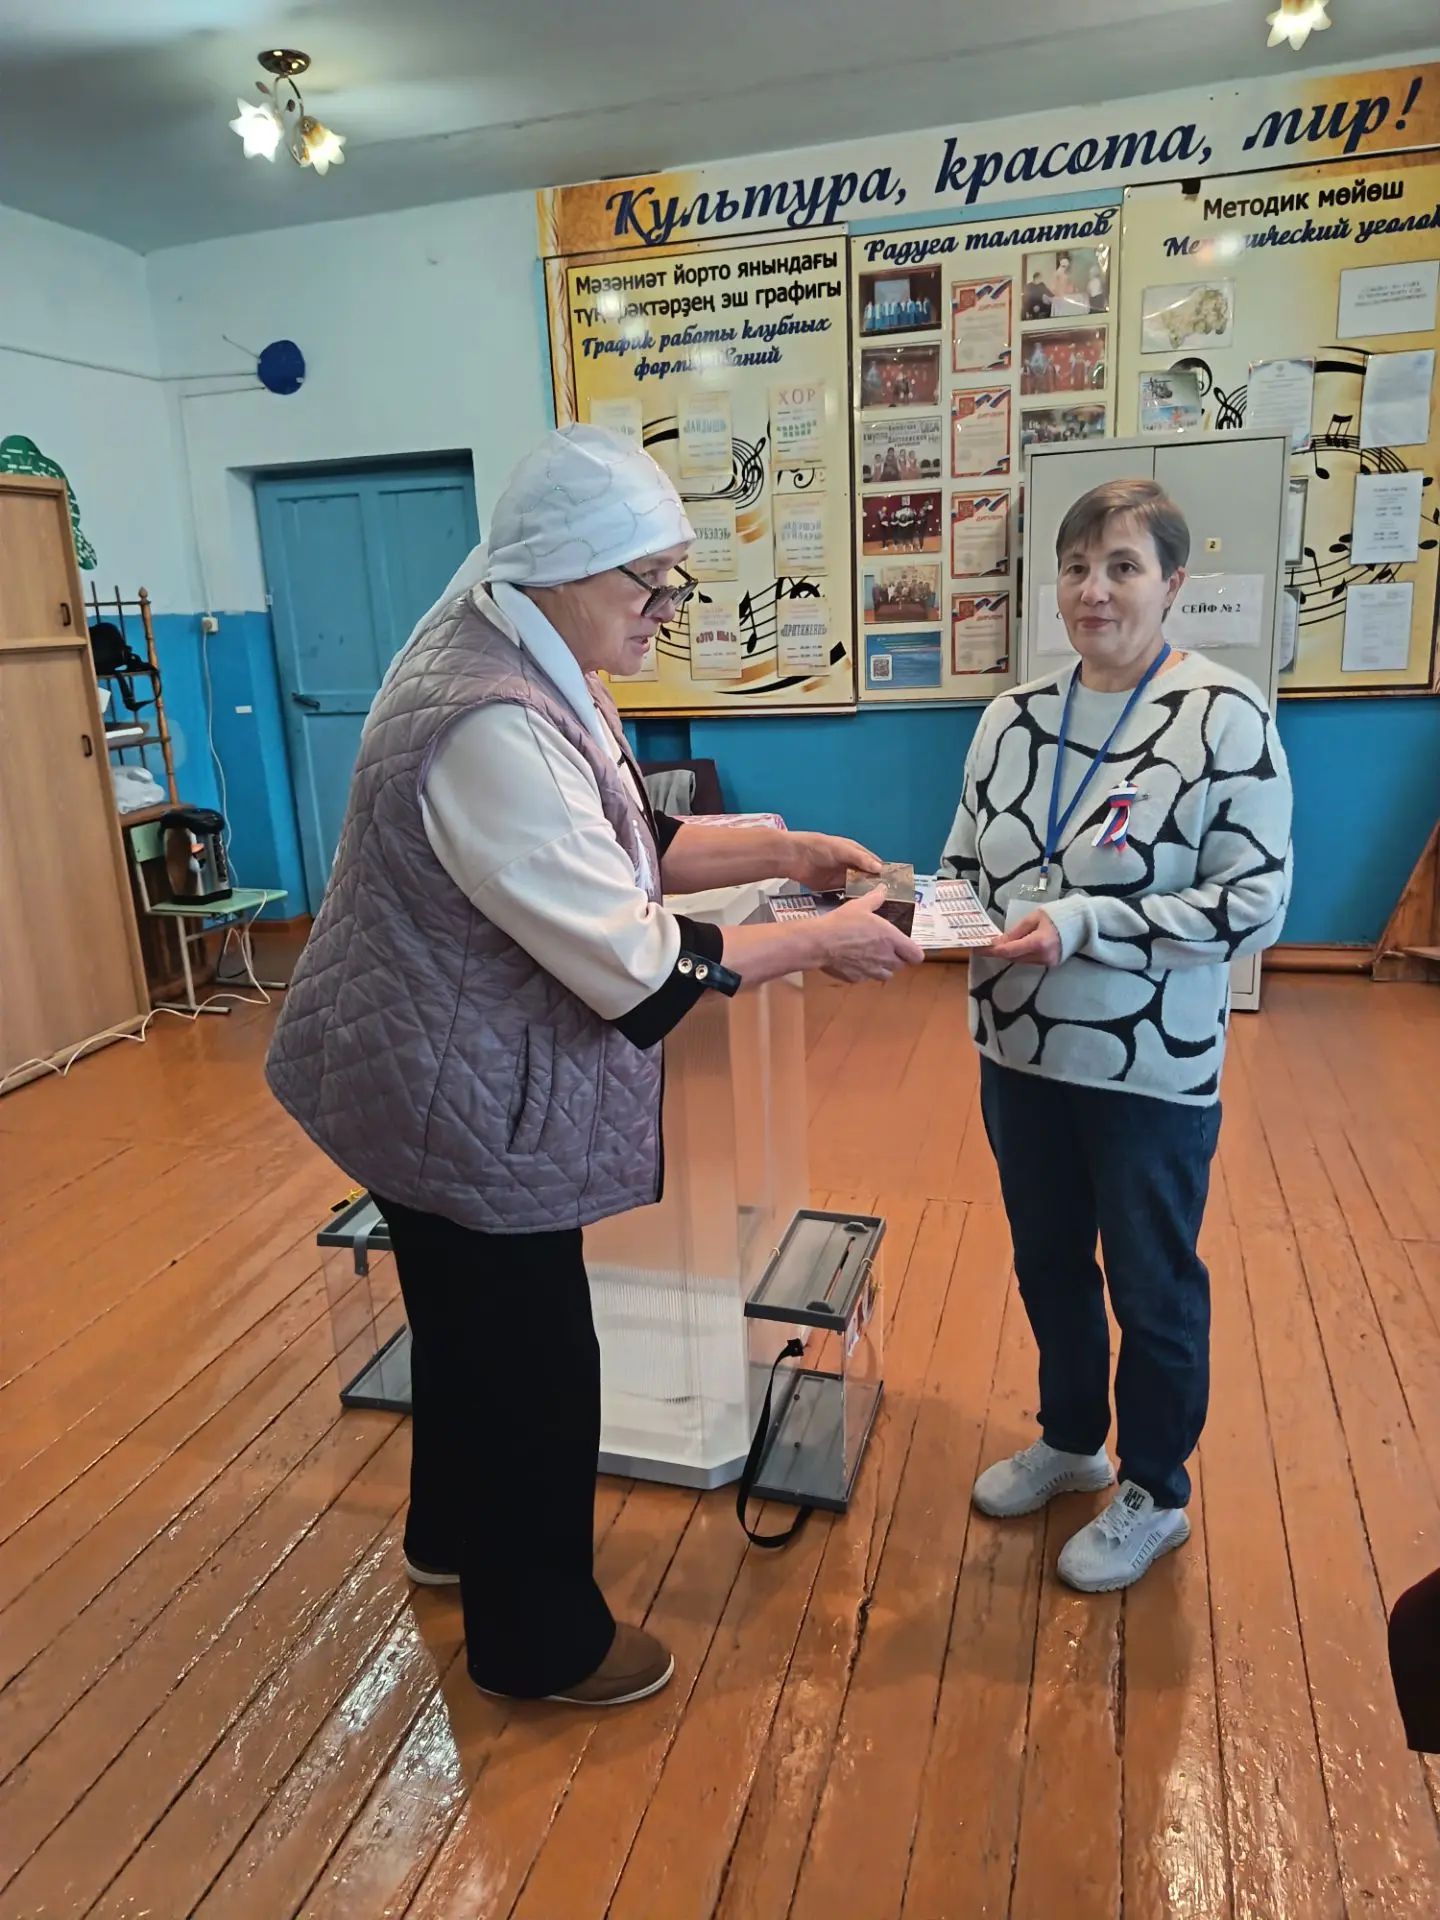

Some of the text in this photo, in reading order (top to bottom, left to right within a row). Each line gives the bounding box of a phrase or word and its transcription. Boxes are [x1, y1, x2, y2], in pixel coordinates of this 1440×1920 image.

[606, 77, 1422, 246] Культура, красота, мир!
[1203, 178, 1403, 220] Методик мөйөш
[864, 208, 1119, 265] Радуга талантов
[674, 264, 731, 286] йорто
[737, 252, 838, 279] янындағы
[721, 291, 748, 309] эш
[755, 280, 842, 307] графигы
[658, 322, 737, 353] работы
[741, 314, 832, 343] клубных
[778, 388, 816, 405] ХОР
[1209, 541, 1216, 549] 2
[1181, 603, 1241, 614] СЕЙФ № 2
